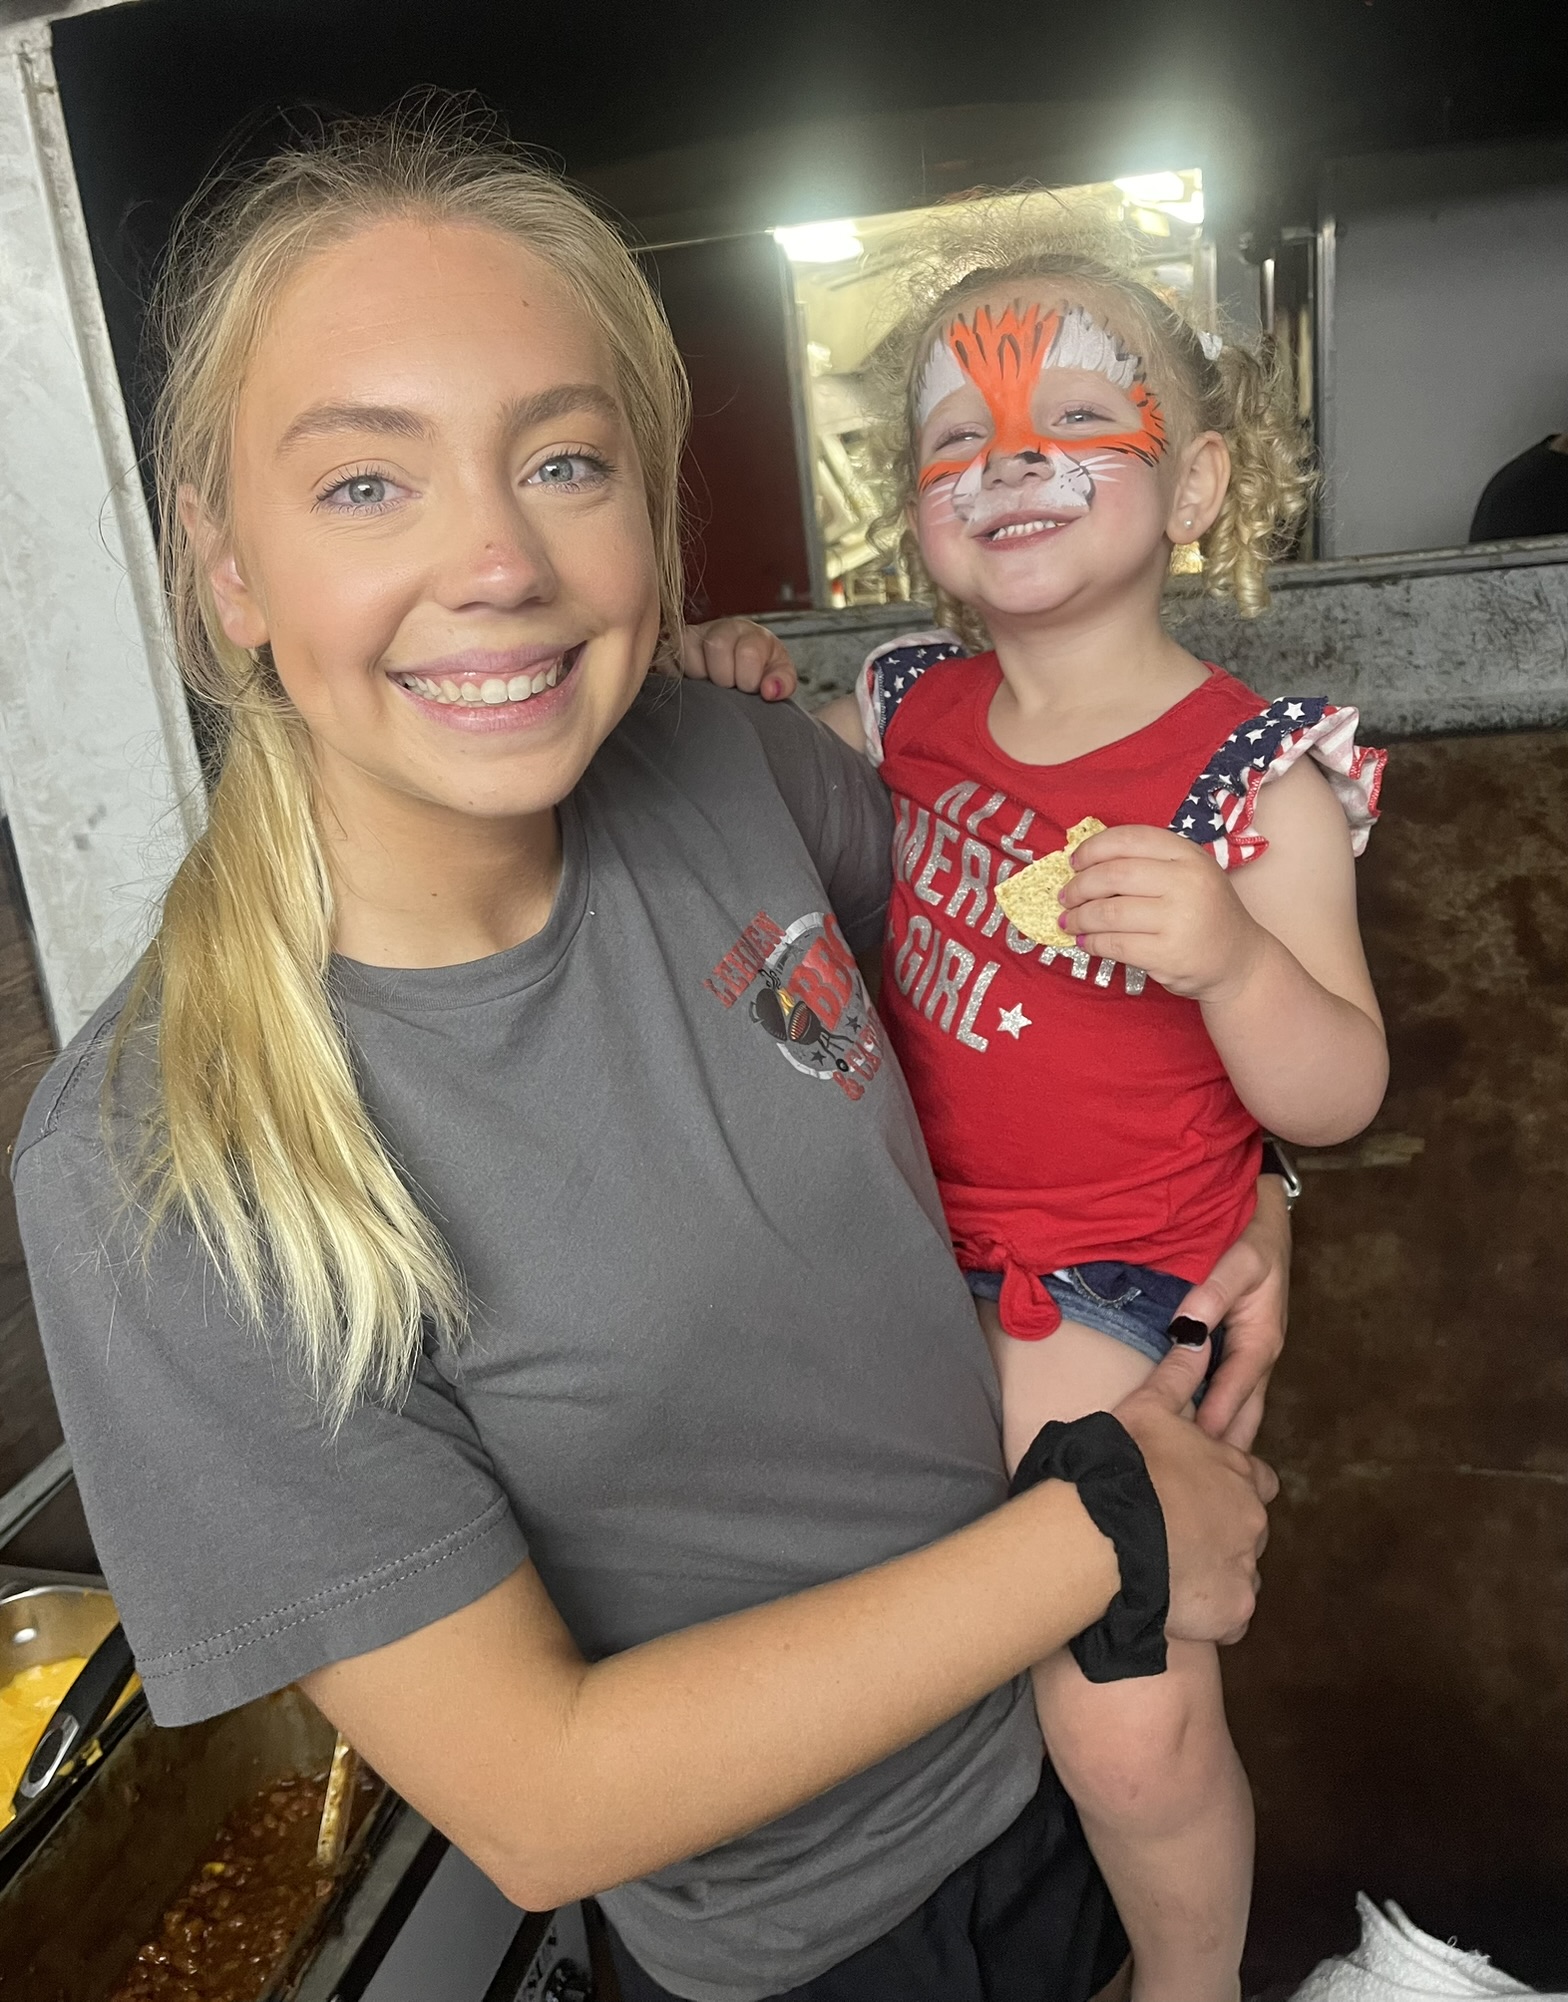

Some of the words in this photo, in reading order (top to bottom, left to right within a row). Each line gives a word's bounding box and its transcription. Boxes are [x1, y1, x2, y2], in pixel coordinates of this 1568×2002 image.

[933, 780, 1036, 863] ALL
[892, 797, 1147, 995] MERI
[894, 915, 1001, 1052] GIRL
